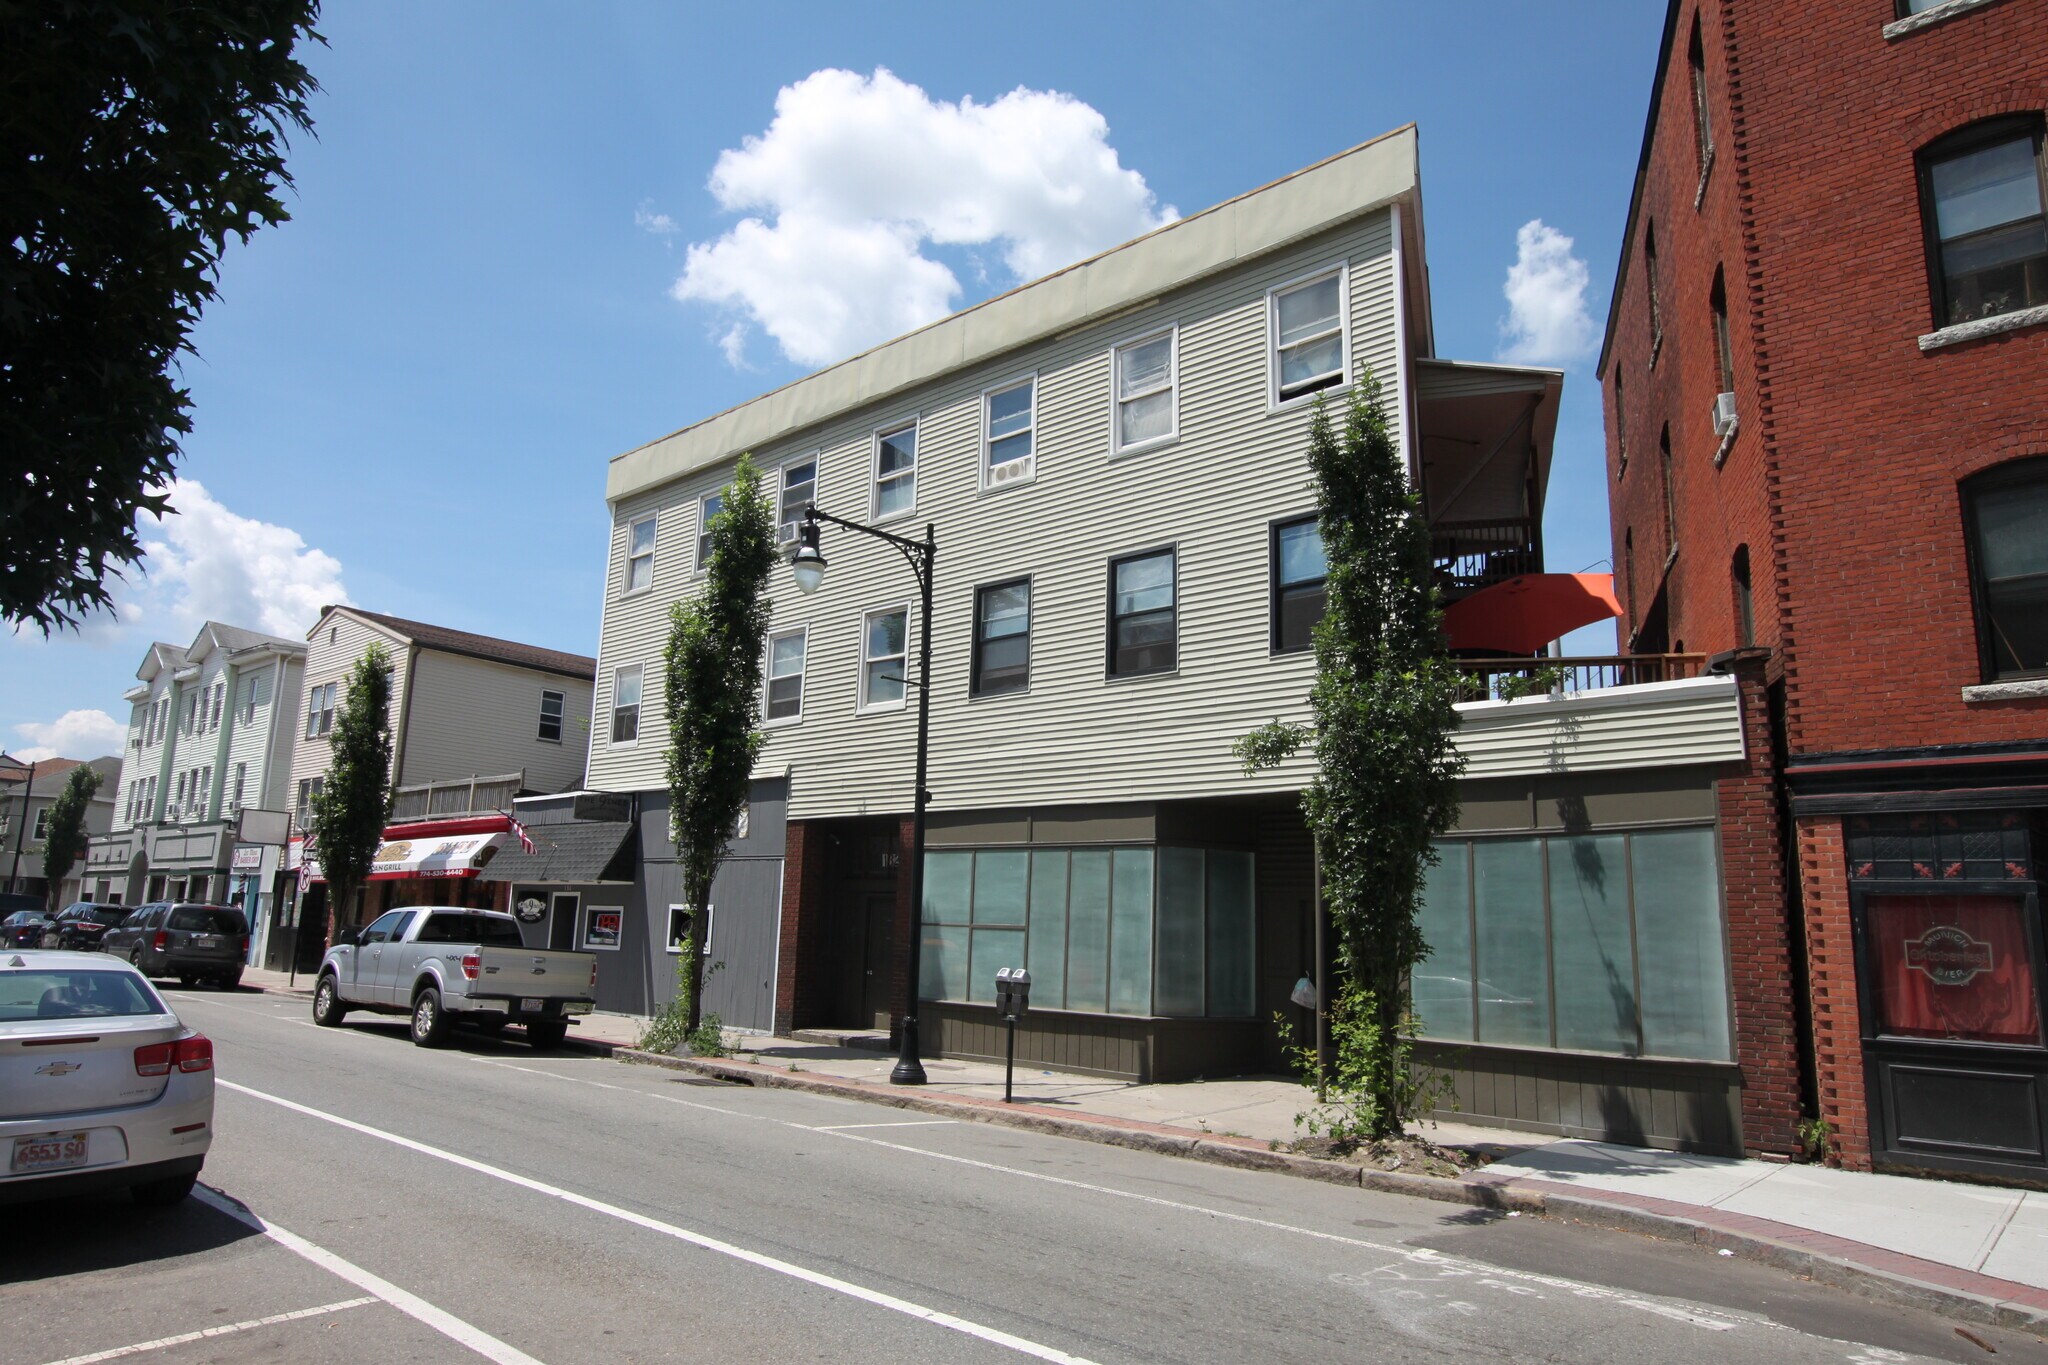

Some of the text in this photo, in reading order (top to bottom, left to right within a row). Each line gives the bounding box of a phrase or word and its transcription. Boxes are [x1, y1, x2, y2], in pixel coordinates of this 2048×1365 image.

[383, 863, 401, 872] GRILL
[420, 869, 463, 877] 774-530-6440
[1924, 931, 1969, 948] MUNICH
[1910, 949, 1986, 962] Oktoberfest
[17, 1143, 61, 1164] 6553
